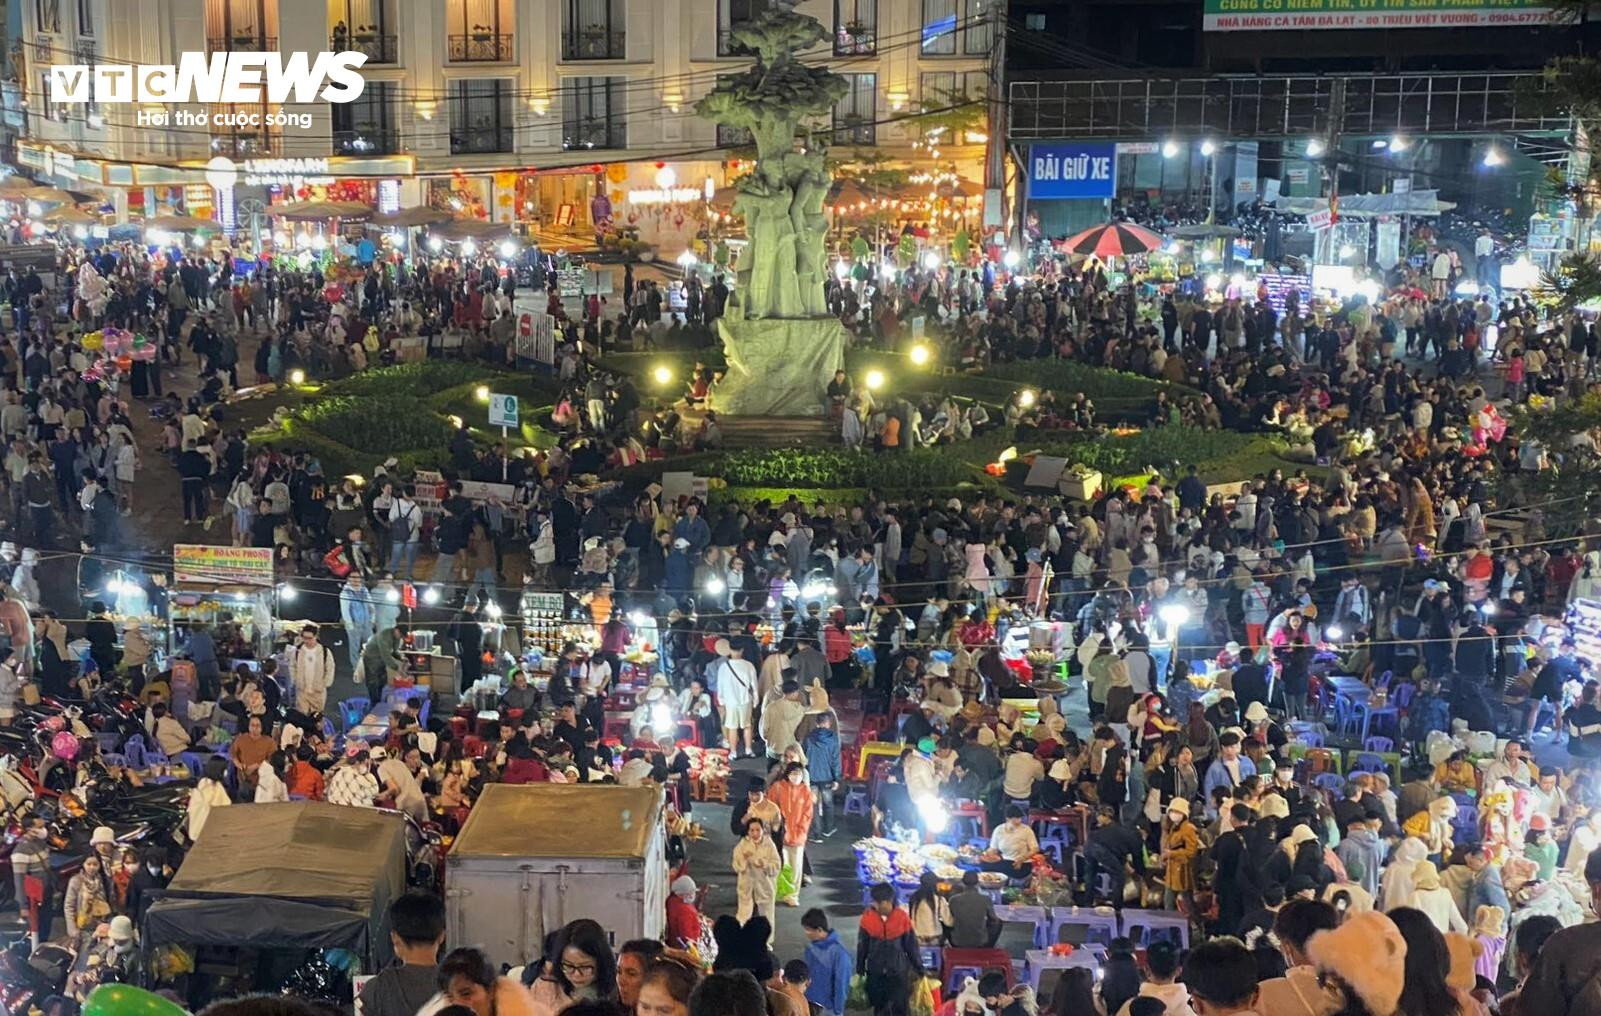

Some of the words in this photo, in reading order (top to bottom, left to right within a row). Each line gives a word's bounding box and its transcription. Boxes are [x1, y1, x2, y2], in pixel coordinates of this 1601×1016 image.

[1035, 153, 1060, 180] BÃI
[1063, 153, 1090, 180] GIỮ
[1091, 157, 1110, 180] XE
